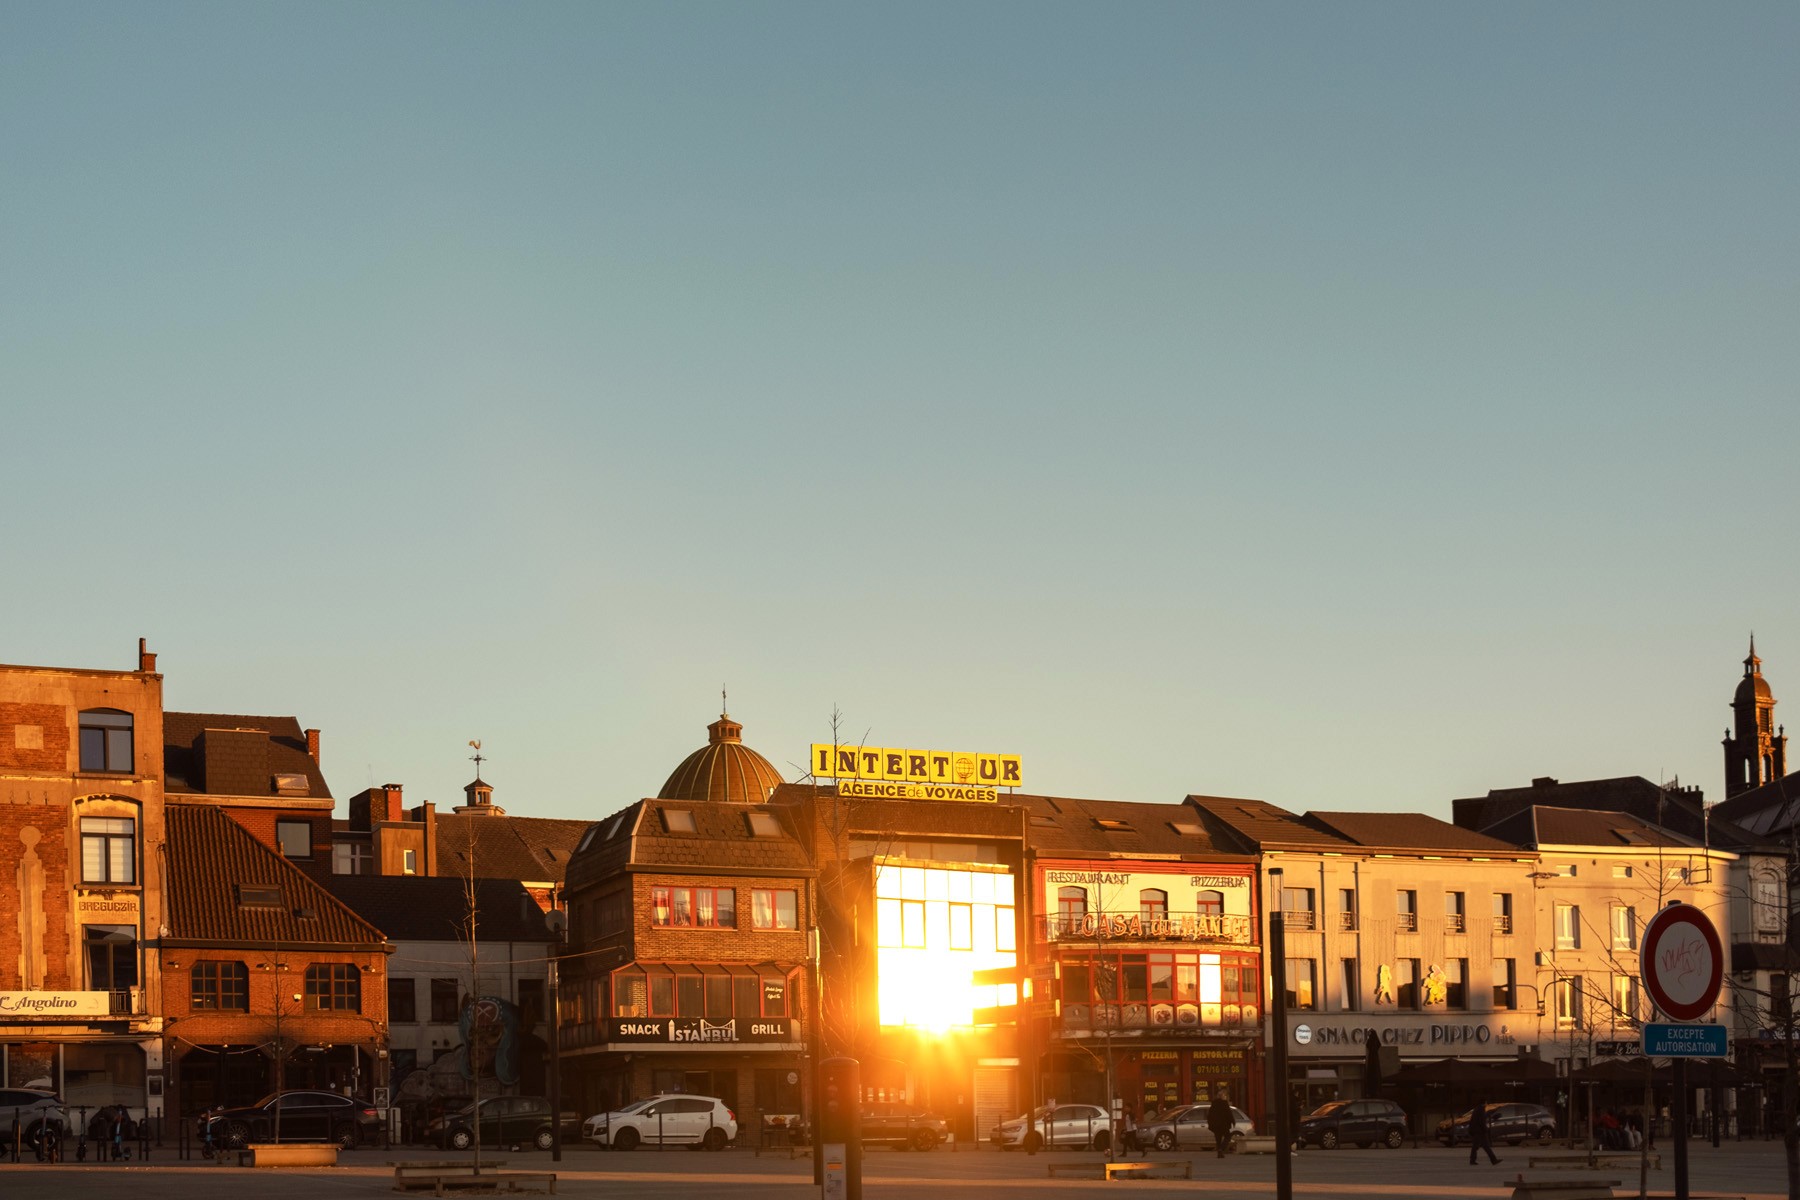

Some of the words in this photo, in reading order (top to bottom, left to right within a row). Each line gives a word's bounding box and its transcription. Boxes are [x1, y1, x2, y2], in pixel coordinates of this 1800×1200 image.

[841, 784, 906, 797] AGENCE
[907, 784, 924, 798] de
[925, 787, 996, 801] VOYAGES
[1047, 872, 1131, 885] RESTAURANT
[1190, 876, 1247, 888] PIZZERIA
[1082, 914, 1143, 937] CASA
[1151, 914, 1172, 936] du
[1181, 914, 1250, 938] MANEGE
[619, 1024, 661, 1035] SNACK
[751, 1024, 784, 1035] GRILL
[1381, 1027, 1425, 1044] CHEZ
[1429, 1024, 1491, 1045] PIPPO
[1667, 1028, 1705, 1039] EXCEPTE
[1656, 1041, 1717, 1053] AUTORISATION
[1142, 1051, 1178, 1059] PIZZERIA
